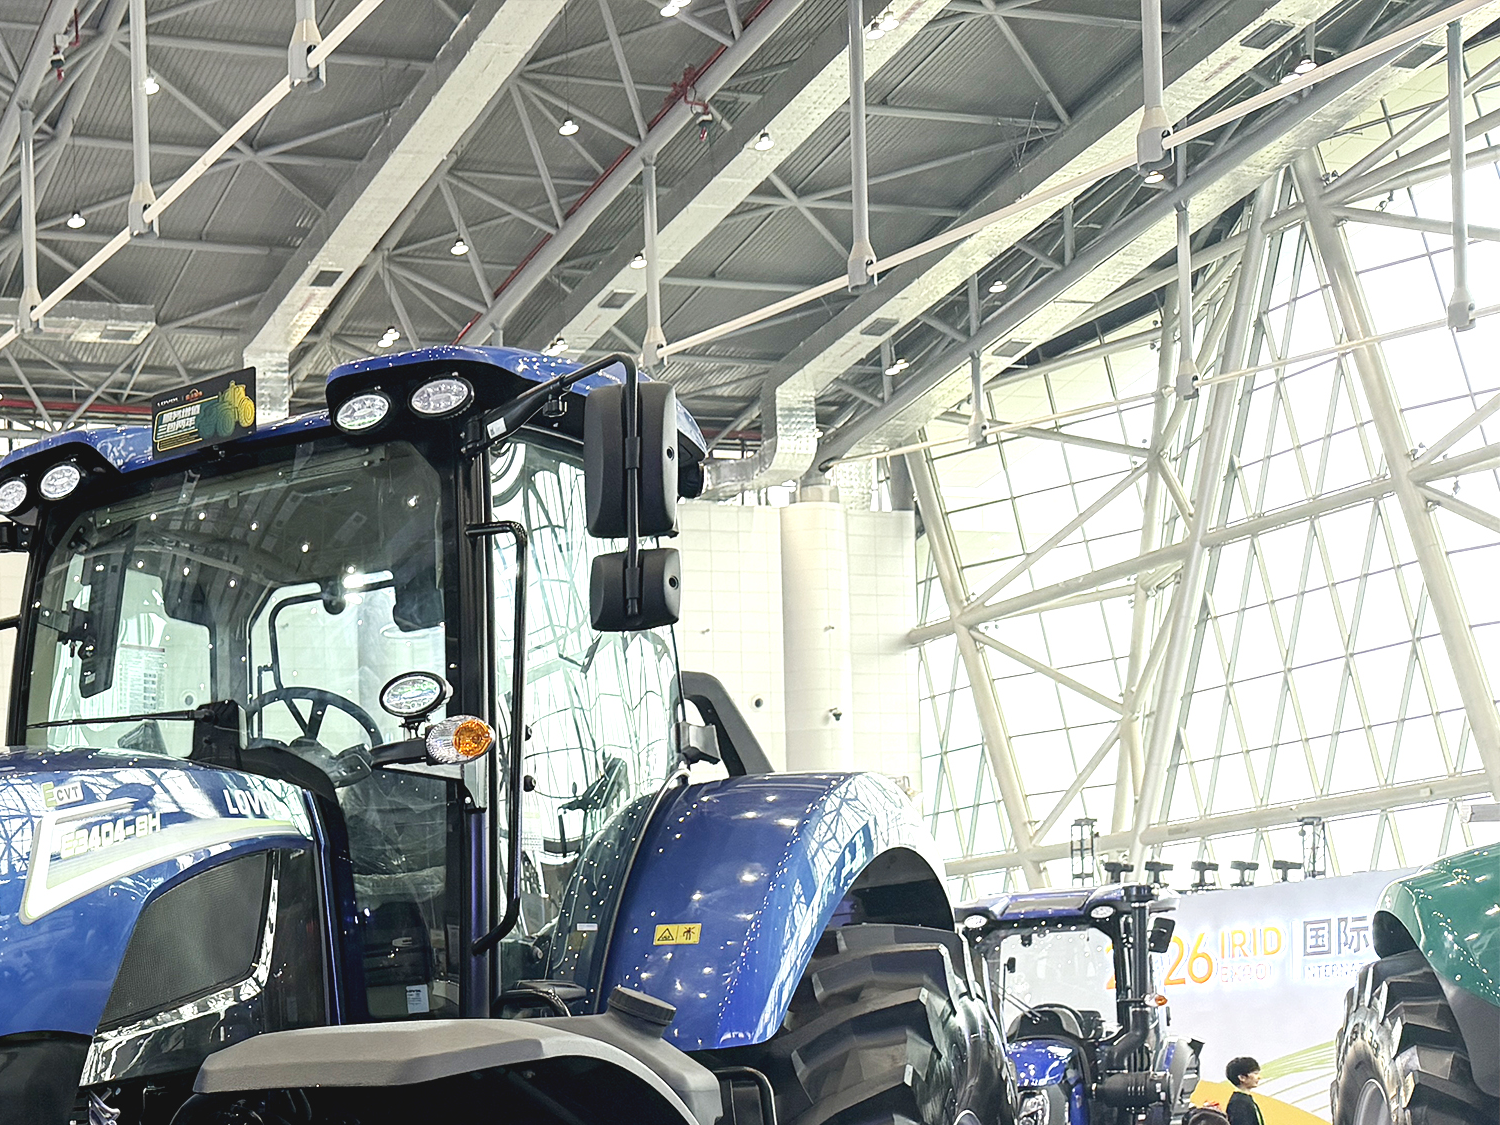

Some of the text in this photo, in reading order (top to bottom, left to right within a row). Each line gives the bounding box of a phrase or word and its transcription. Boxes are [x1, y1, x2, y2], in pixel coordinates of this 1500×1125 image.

[60, 811, 161, 860] E3404-8H
[1220, 926, 1283, 959] IRID
[1303, 915, 1370, 957] 国际
